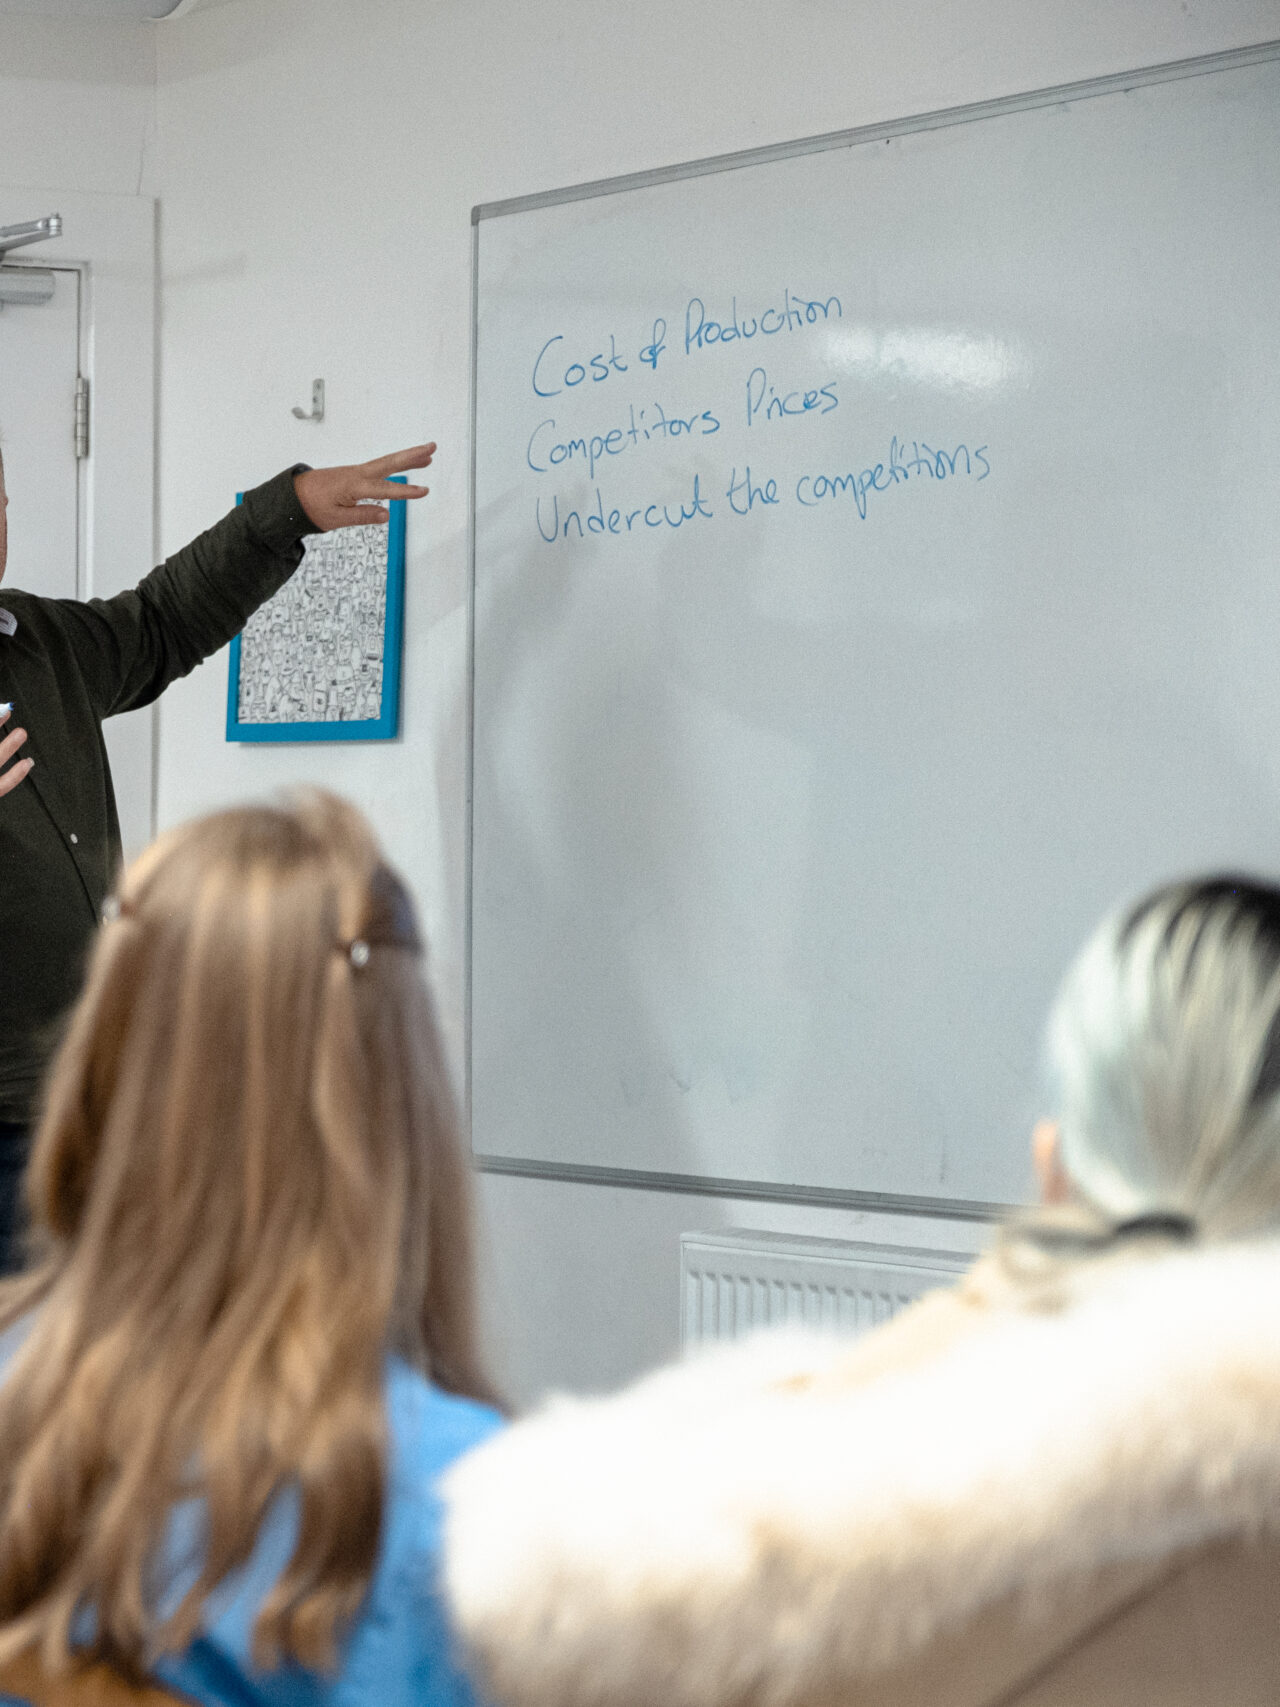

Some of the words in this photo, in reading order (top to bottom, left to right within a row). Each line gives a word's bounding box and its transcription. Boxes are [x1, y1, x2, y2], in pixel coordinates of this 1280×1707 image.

[532, 335, 628, 397] Cost
[683, 288, 843, 355] Production
[527, 402, 721, 479] Competitors
[745, 367, 840, 427] Prices
[535, 473, 713, 543] Undercut
[726, 466, 781, 517] the
[795, 435, 991, 519] competitions
